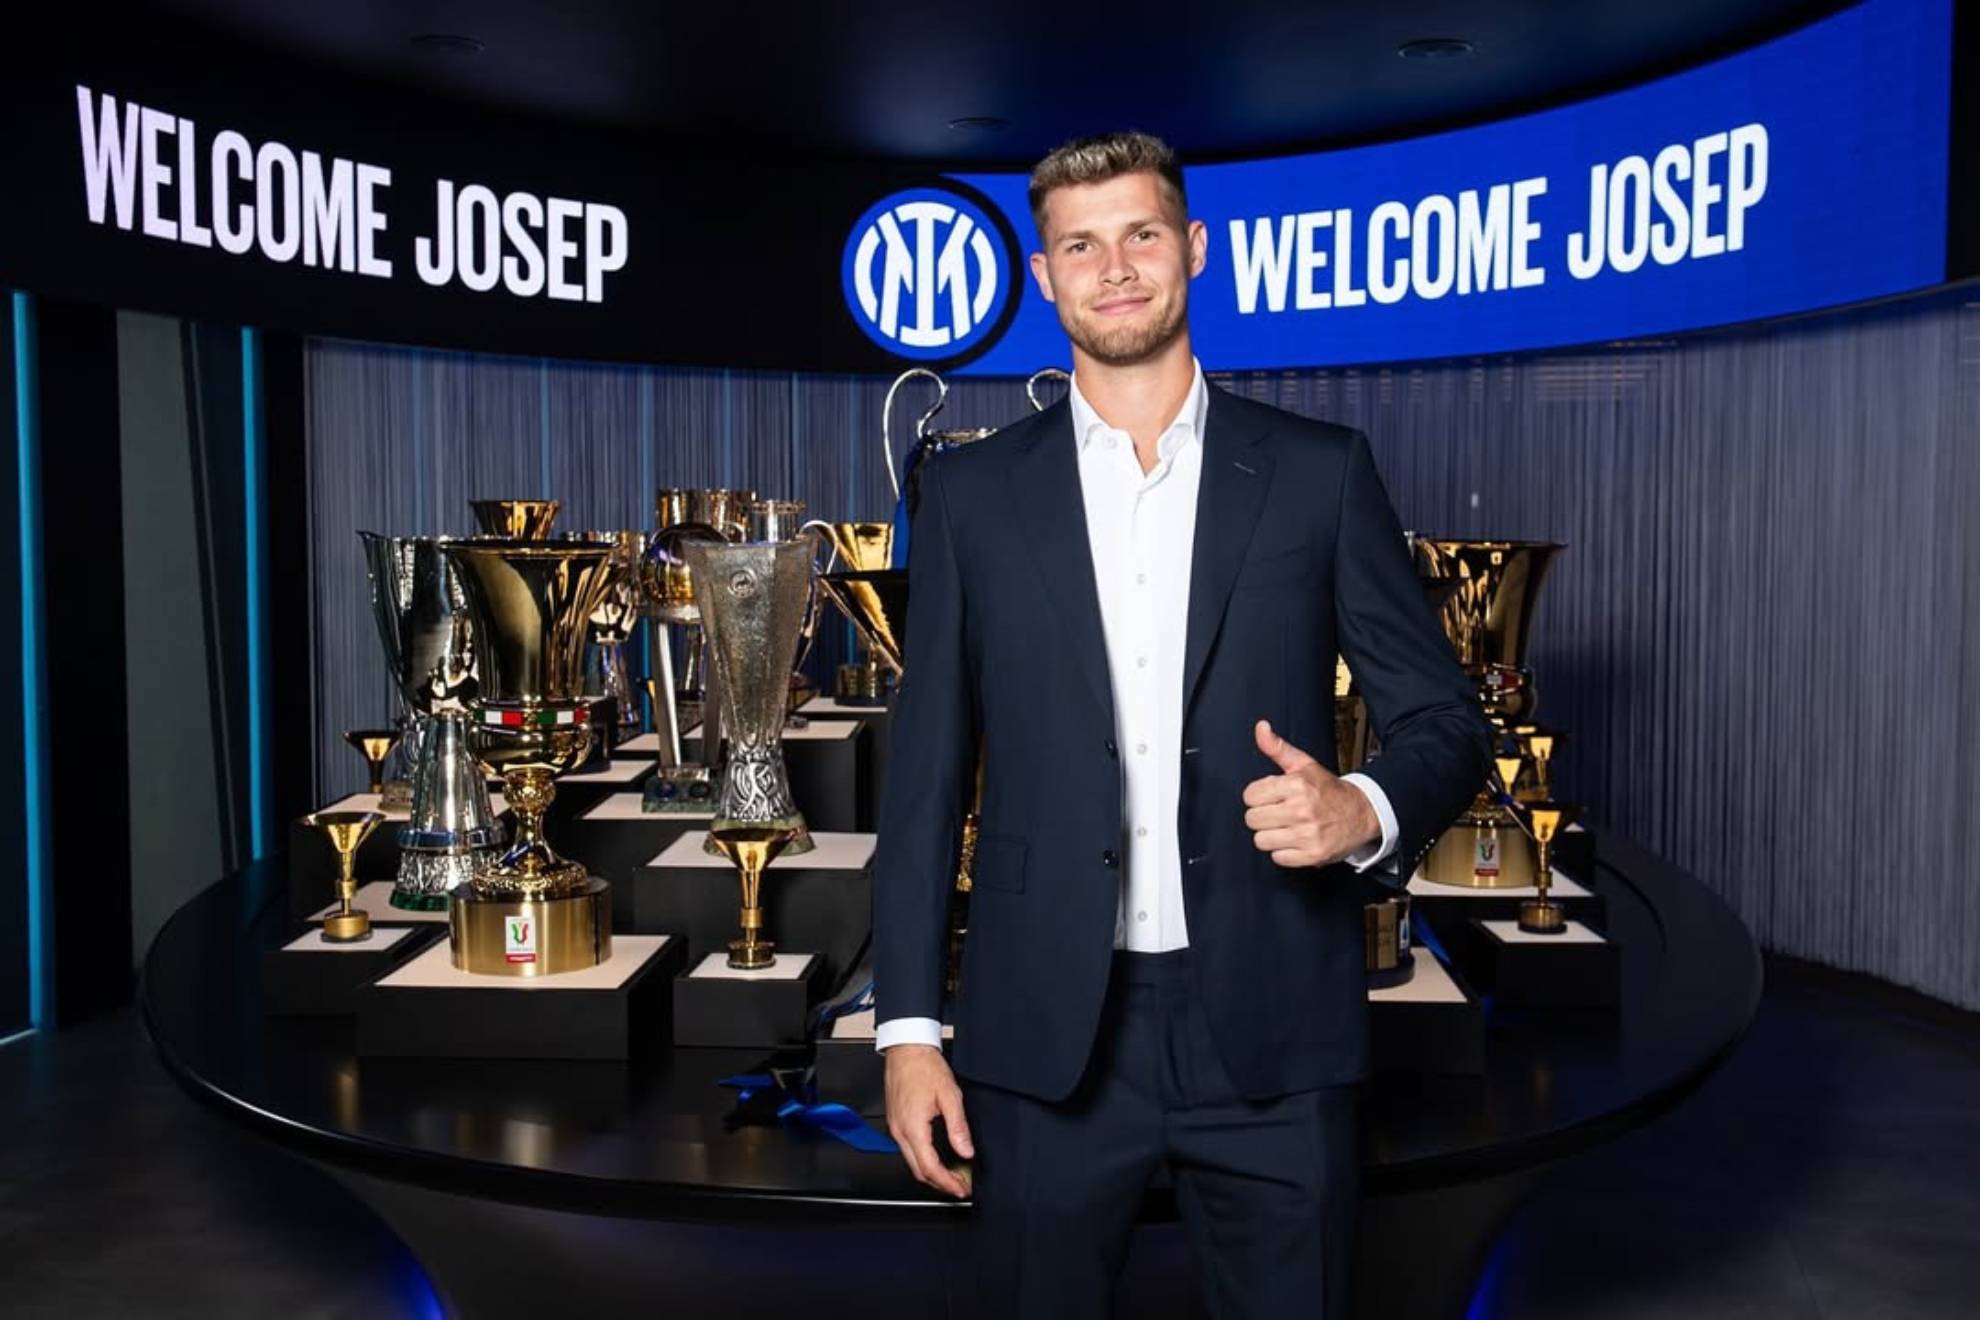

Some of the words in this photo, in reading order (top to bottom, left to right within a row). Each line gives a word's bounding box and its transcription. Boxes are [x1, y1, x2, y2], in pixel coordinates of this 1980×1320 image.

[77, 85, 392, 278] WELCOME
[415, 179, 628, 303] JOSEP
[1229, 177, 1547, 314] WELCOME
[1567, 123, 1768, 279] JOSEP
